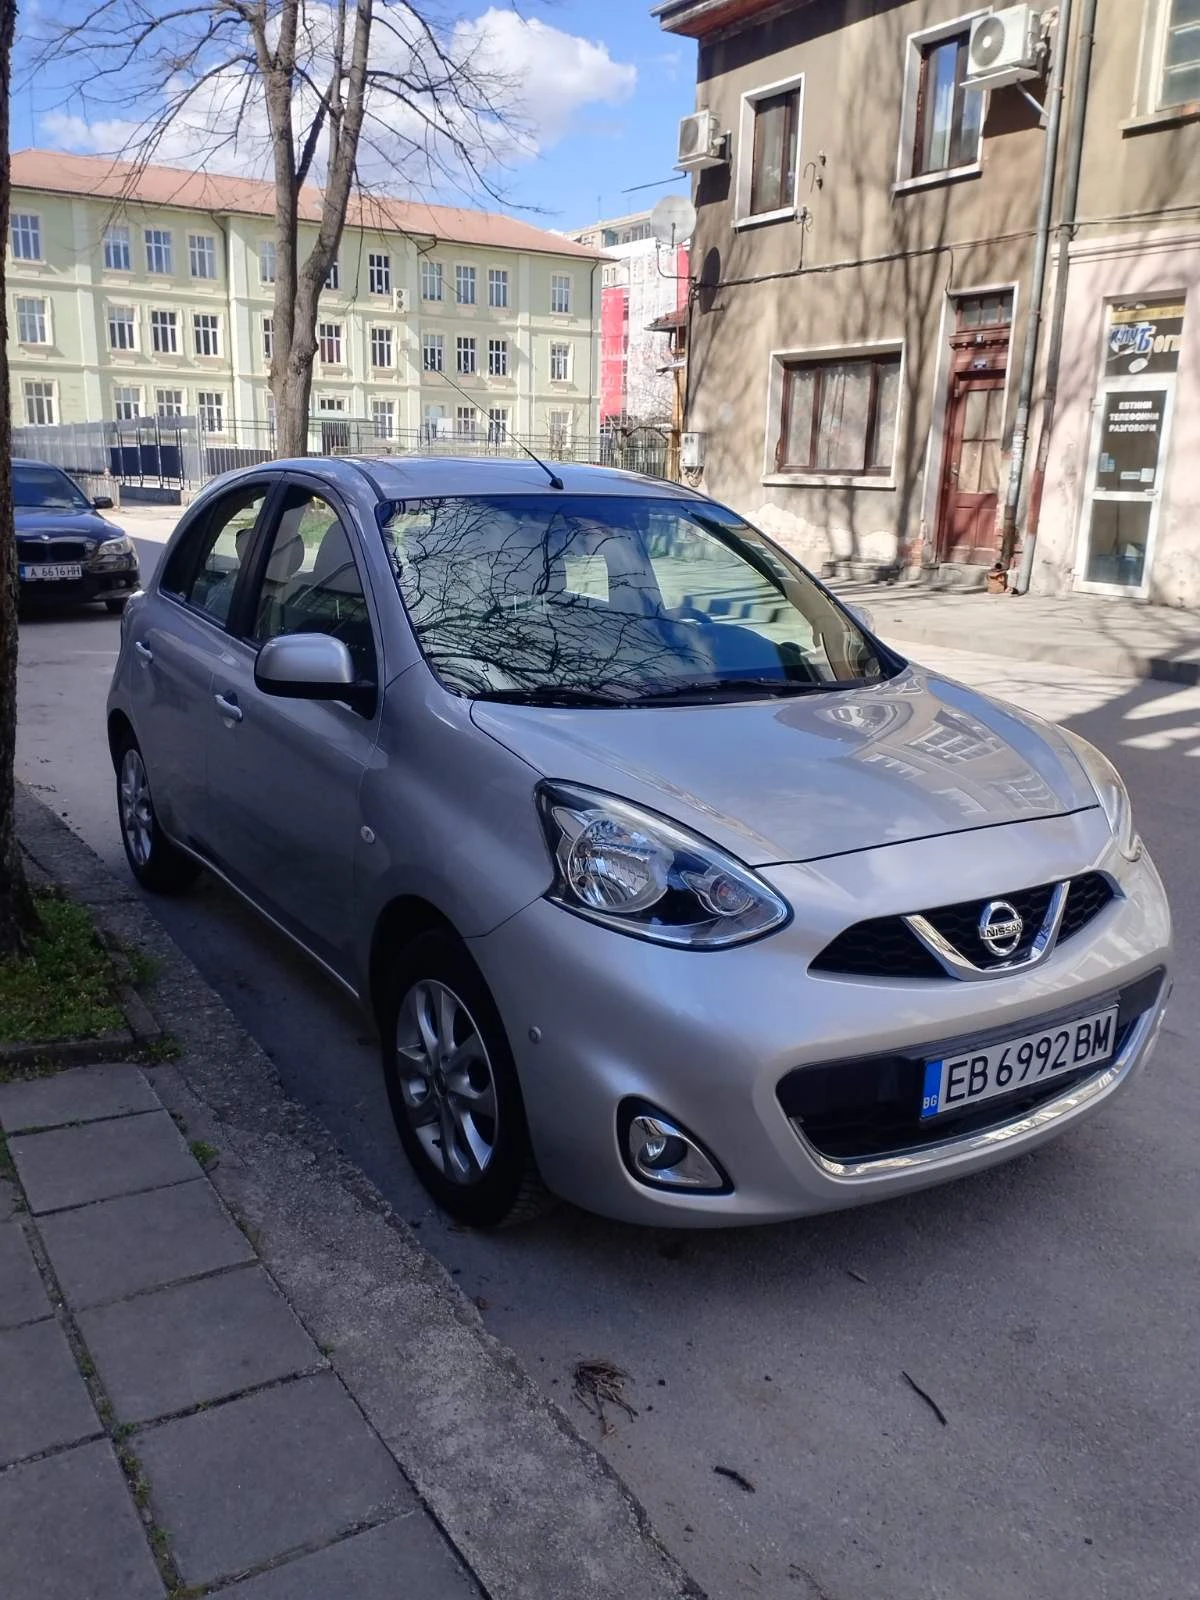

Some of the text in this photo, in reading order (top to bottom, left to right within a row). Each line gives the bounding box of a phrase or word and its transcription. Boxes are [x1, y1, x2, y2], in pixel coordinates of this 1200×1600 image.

[1118, 401, 1153, 410] ЕВТИНИ
[1109, 412, 1160, 421] ТЕЛЕФОННИ
[1108, 424, 1157, 432] РАЗГОВОРИ
[986, 923, 1022, 938] NISSAN
[922, 1095, 938, 1109] BG
